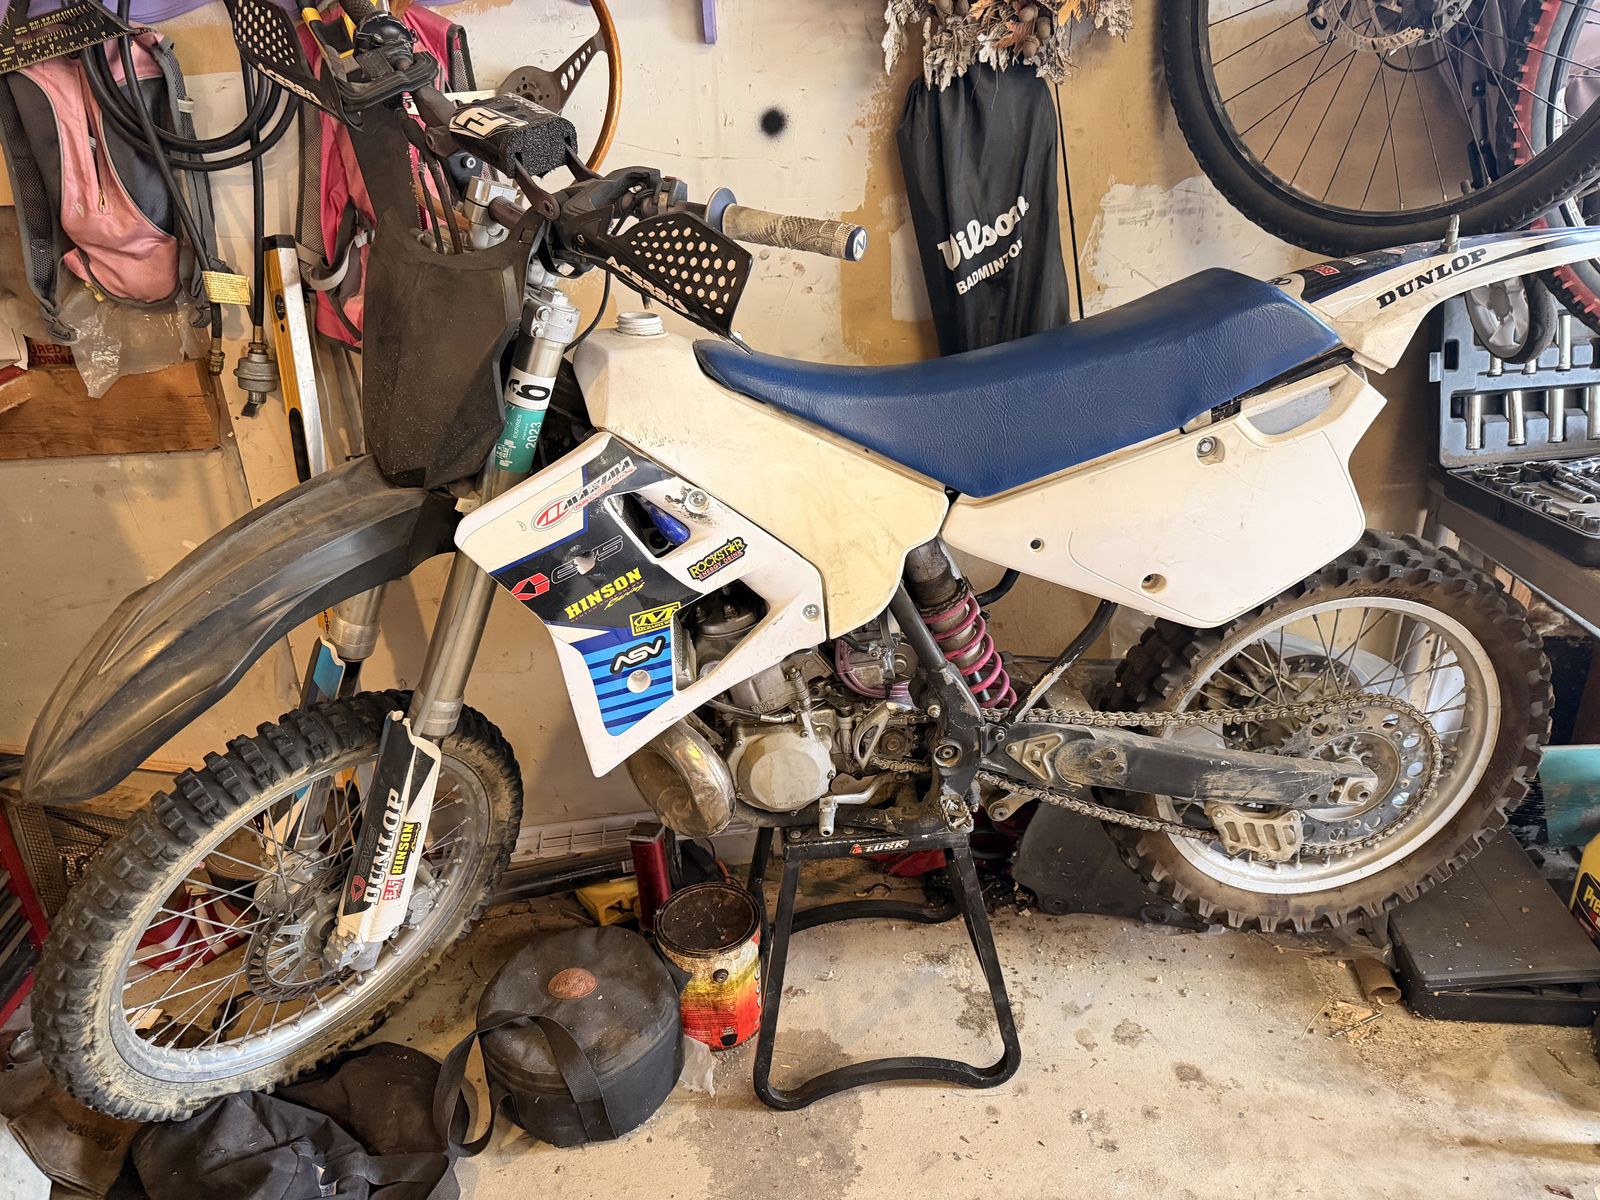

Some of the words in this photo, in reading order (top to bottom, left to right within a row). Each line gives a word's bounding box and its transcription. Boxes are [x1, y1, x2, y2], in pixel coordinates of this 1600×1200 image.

[1376, 247, 1487, 309] DUNLOP
[525, 421, 542, 449] 2023
[698, 562, 721, 580] ENERGY
[722, 549, 743, 565] DRINK
[563, 567, 643, 620] HINSON
[614, 639, 662, 671] ASV
[363, 787, 404, 905] DUNLOP
[391, 823, 415, 876] HINSON
[865, 840, 910, 853] TUSK
